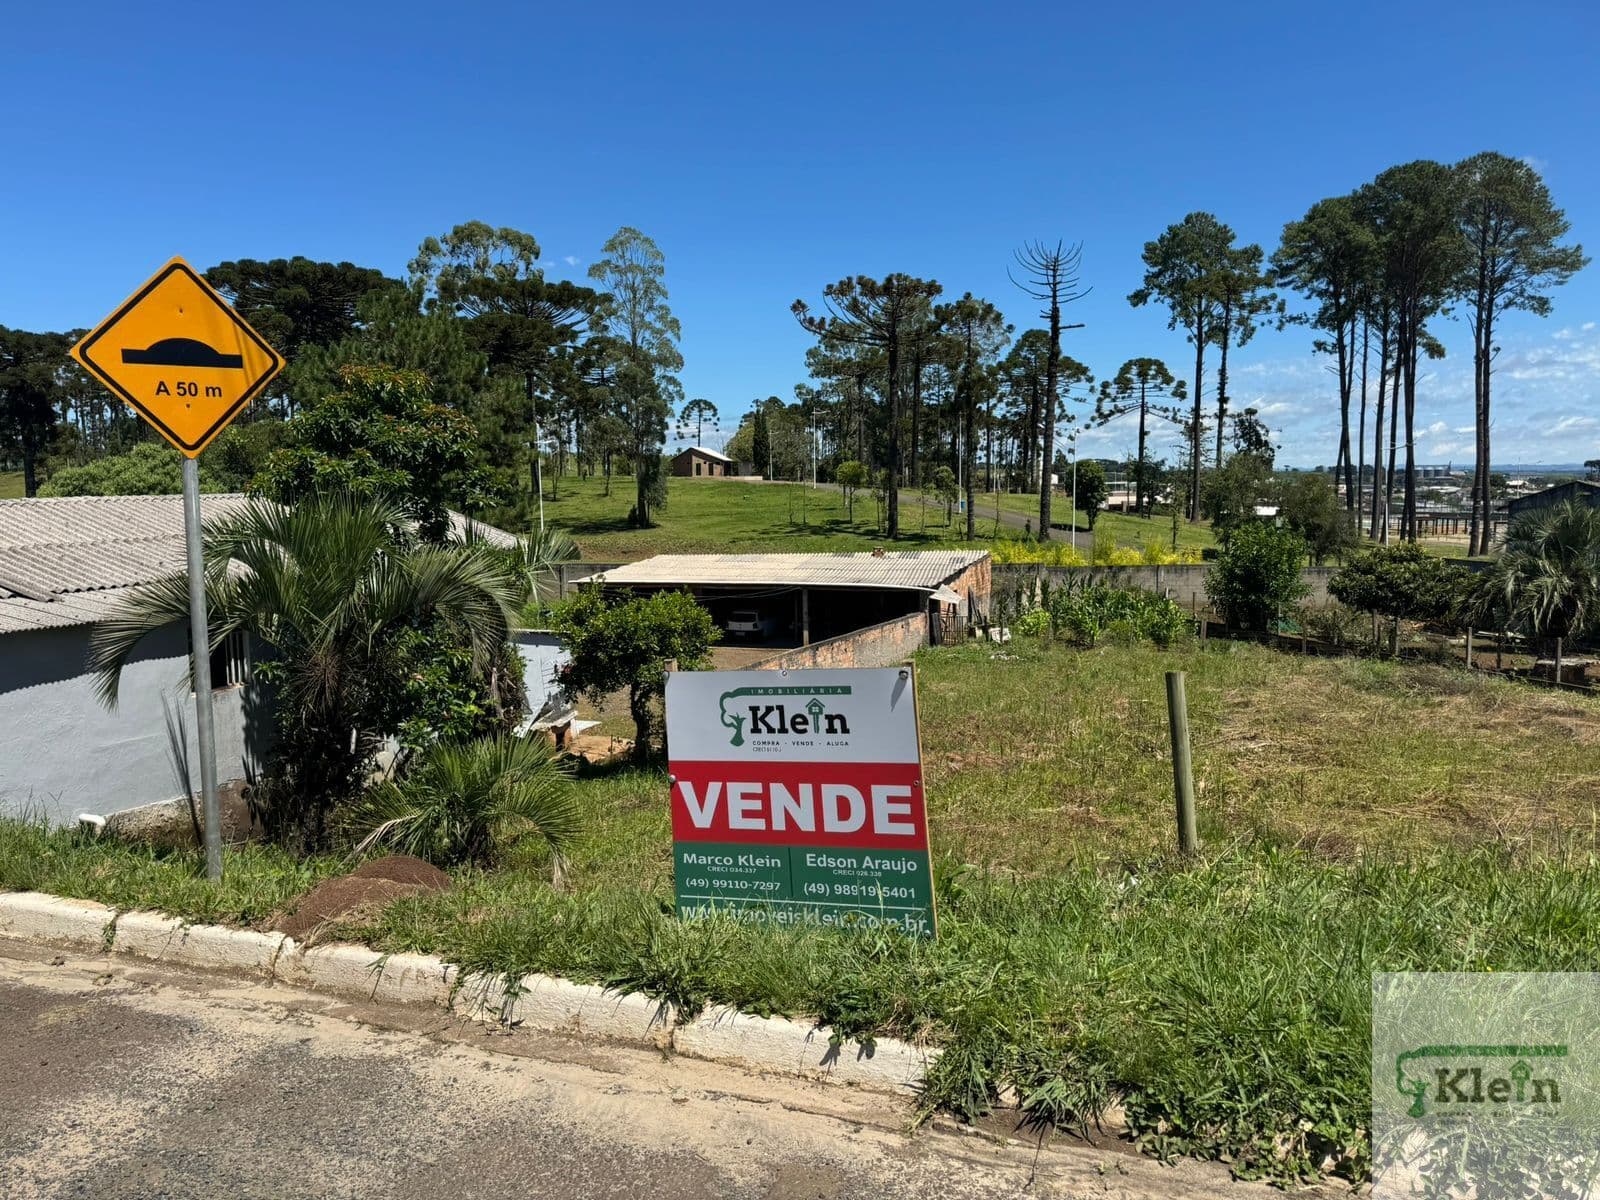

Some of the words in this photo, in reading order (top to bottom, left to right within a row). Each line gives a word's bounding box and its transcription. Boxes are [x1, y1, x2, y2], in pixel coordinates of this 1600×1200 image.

[155, 381, 170, 396] A
[176, 382, 198, 397] 50
[205, 385, 222, 397] m
[748, 698, 850, 734] Klein
[678, 781, 916, 836] VENDE
[683, 853, 733, 866] Marco
[738, 854, 781, 868] Klein
[806, 853, 857, 868] Edson
[862, 856, 918, 874] Araujo
[685, 877, 709, 889] (49)
[712, 879, 781, 891] 99110-7297
[804, 882, 830, 897] (49)
[834, 884, 915, 899] 989195401
